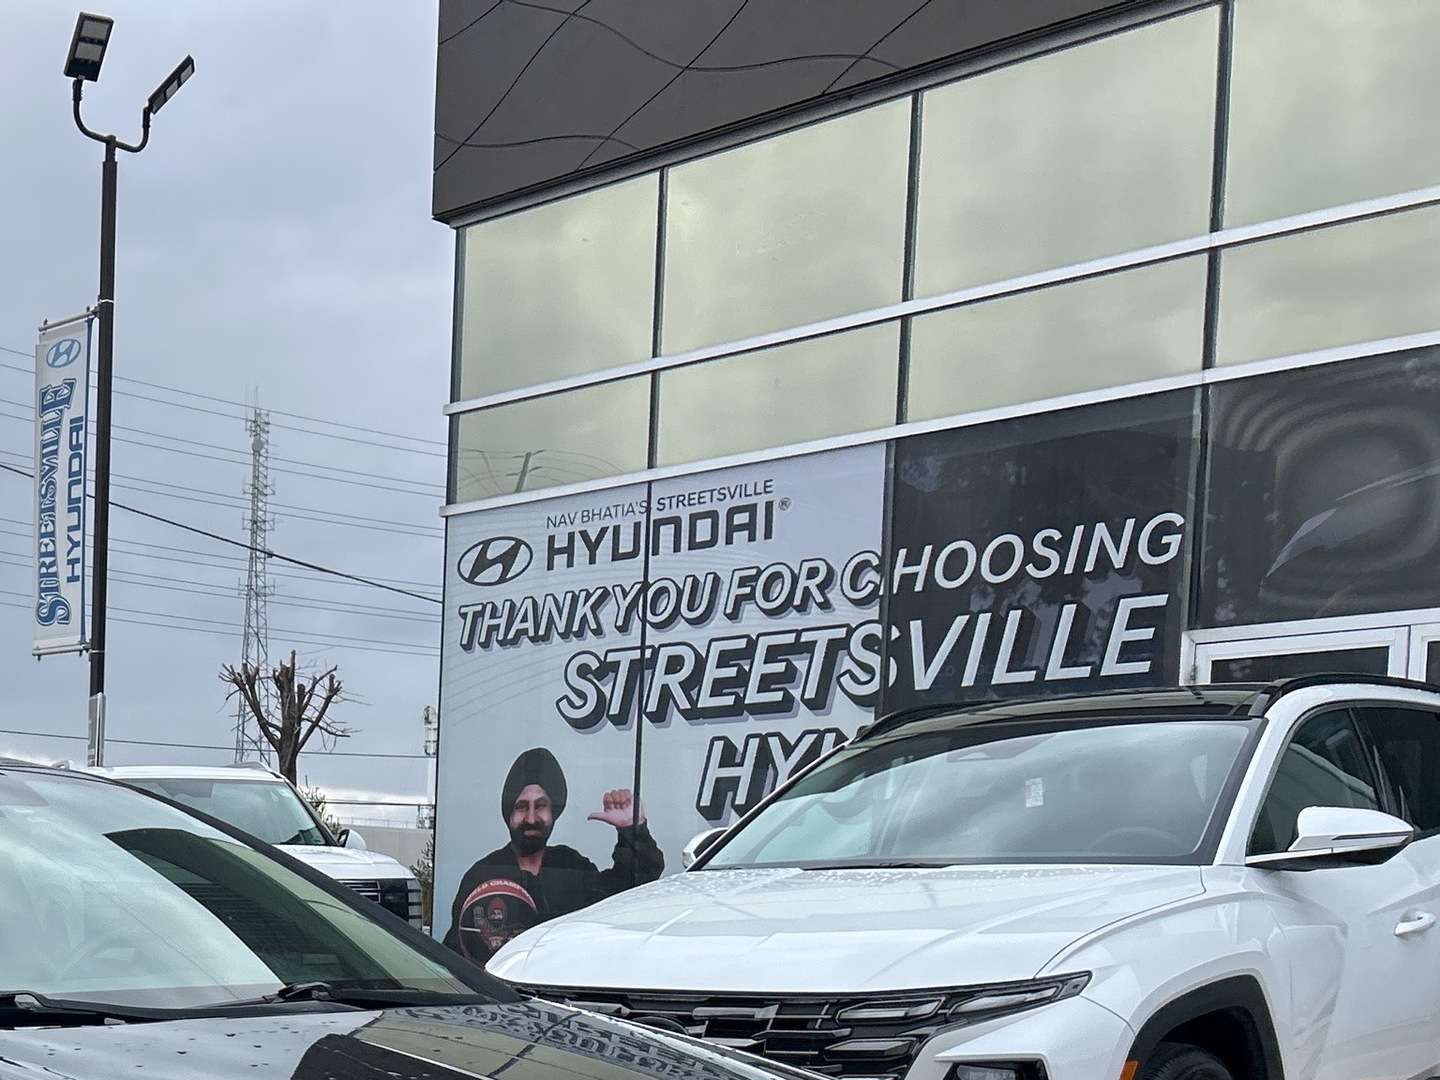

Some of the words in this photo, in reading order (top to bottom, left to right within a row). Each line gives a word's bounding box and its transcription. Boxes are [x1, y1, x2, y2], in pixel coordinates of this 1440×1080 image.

[36, 378, 77, 626] STREETSVILLE
[66, 416, 84, 583] HYUNDAI
[546, 511, 579, 529] NAV
[580, 500, 649, 525] BHATIA'S
[656, 479, 775, 512] STREETSVILLE
[459, 588, 610, 650] THANK
[613, 572, 720, 632] YOU
[724, 558, 832, 622] FOR
[840, 511, 1185, 602] CHOOSING
[555, 592, 1169, 729] STREETSVILLE
[697, 729, 844, 819] HY
